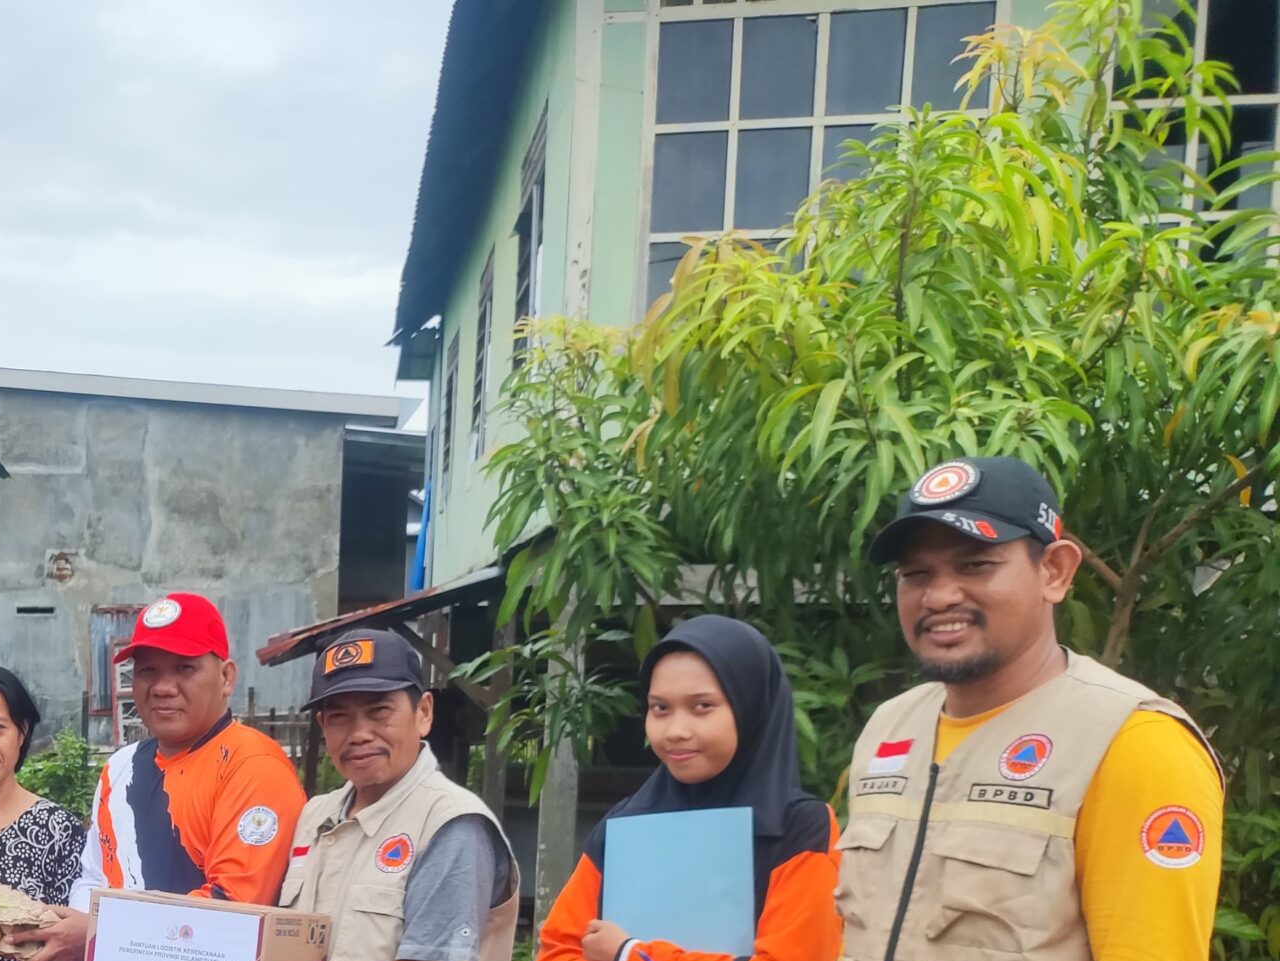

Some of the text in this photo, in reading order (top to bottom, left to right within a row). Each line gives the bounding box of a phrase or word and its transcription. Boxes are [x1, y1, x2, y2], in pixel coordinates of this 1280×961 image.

[978, 788, 1035, 802] BPBD
[118, 946, 154, 956] PEMERINTAH
[154, 952, 180, 960] PROVINSI
[129, 941, 226, 959] BANTUAN LOGISTIK KEBENCANAAN
